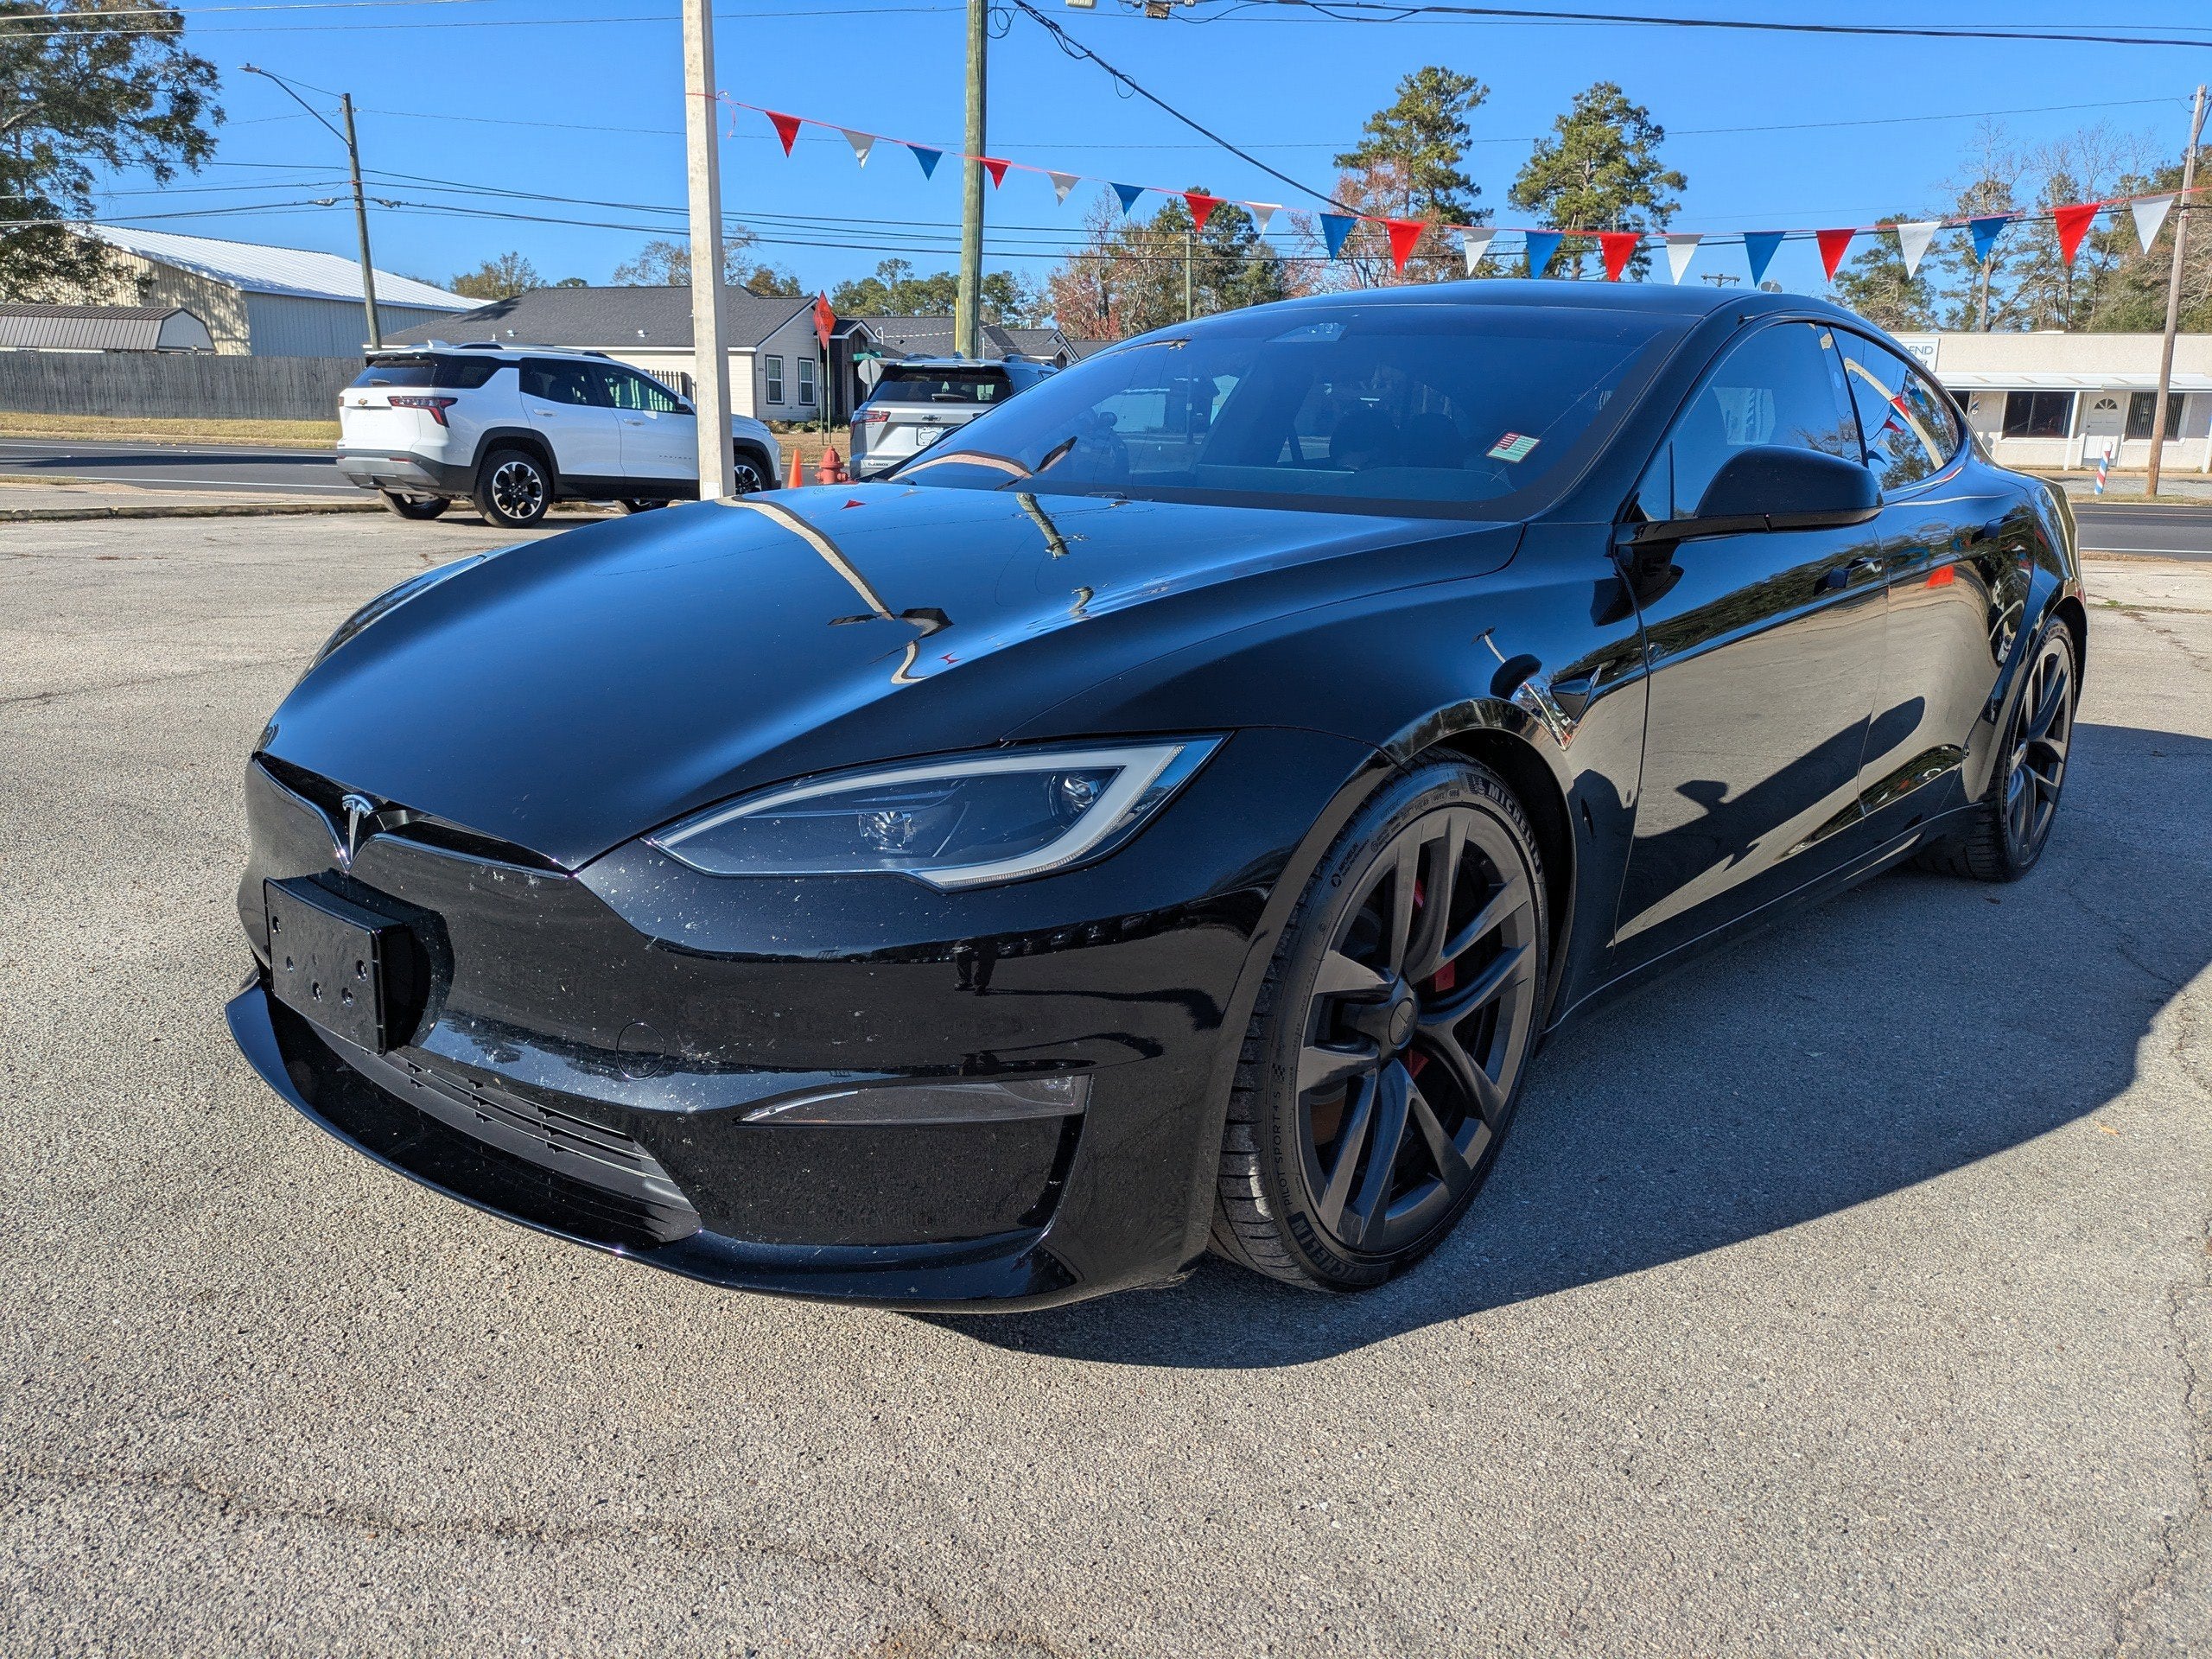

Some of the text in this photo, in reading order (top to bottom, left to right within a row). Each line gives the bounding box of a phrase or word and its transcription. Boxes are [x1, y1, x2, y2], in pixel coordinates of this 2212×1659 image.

[1488, 782, 1541, 867] MICHELIN
[1273, 1090, 1281, 1099] S
[1272, 1115, 1283, 1164] SPORT
[1279, 1171, 1293, 1206] PILOT
[1291, 1218, 1369, 1280] MICHELIN
